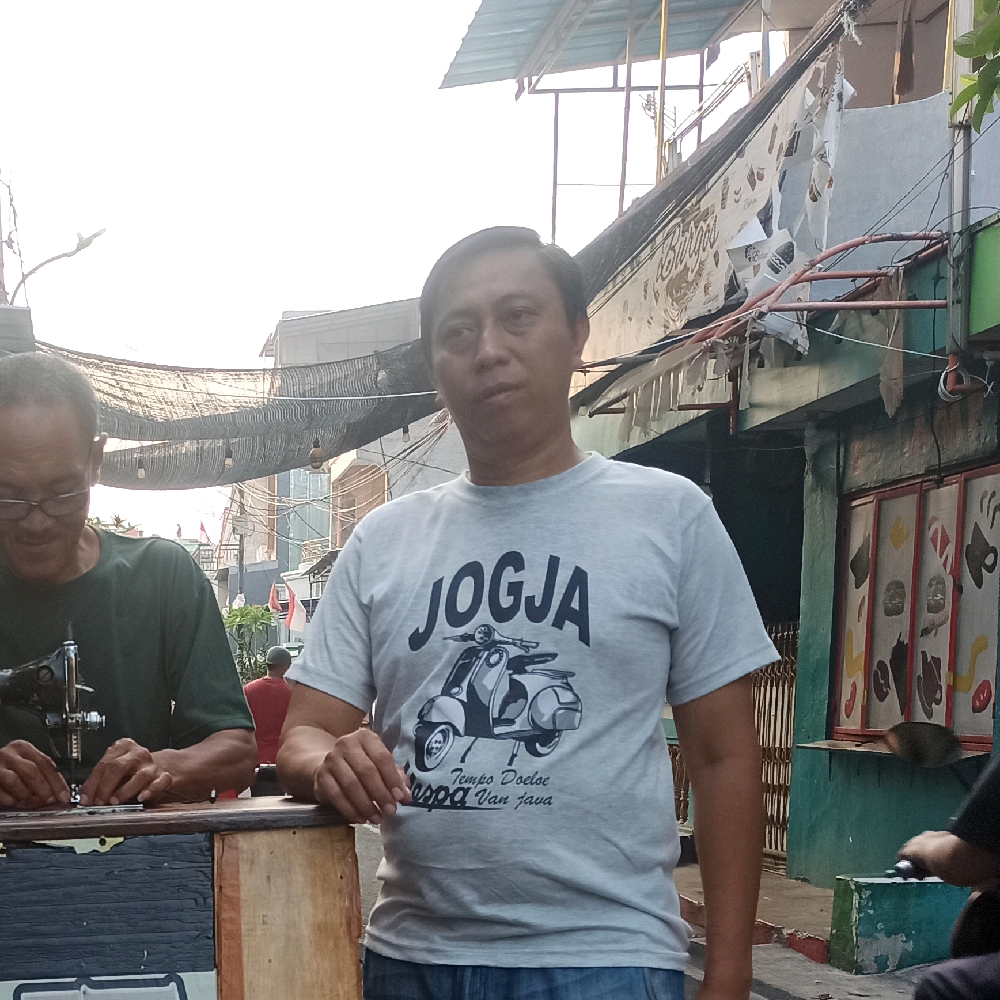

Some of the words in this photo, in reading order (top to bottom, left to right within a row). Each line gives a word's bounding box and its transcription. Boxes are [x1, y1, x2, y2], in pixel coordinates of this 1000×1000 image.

[408, 550, 590, 651] JOGJA
[451, 767, 494, 788] Tempo
[501, 769, 551, 786] Doeloe
[474, 788, 510, 806] Van
[514, 791, 553, 810] java
